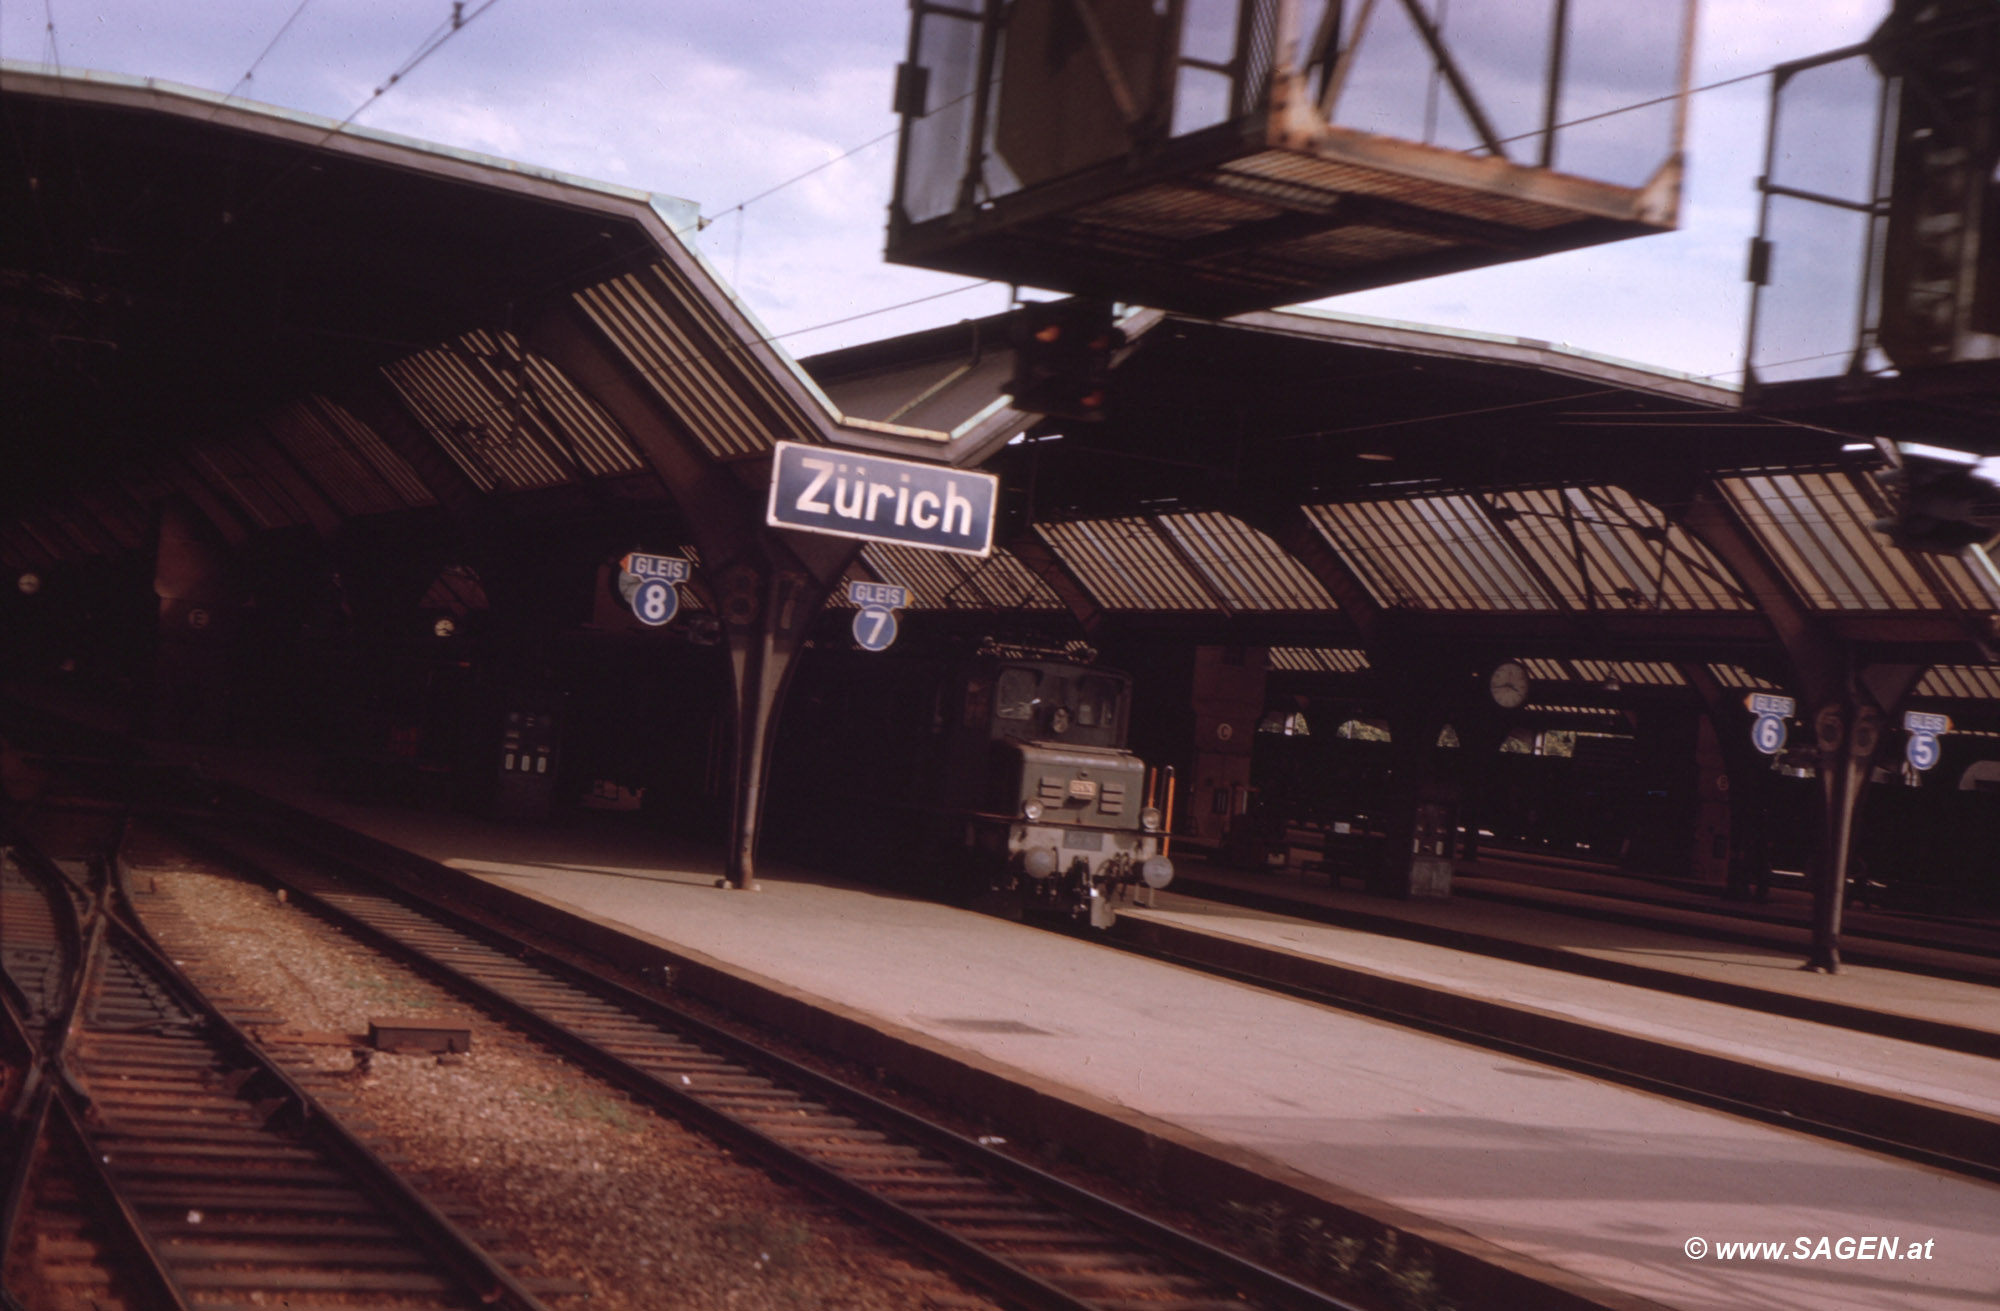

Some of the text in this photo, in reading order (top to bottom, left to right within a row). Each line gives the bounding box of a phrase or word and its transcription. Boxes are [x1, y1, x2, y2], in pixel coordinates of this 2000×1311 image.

[795, 457, 973, 537] Zürich
[635, 557, 683, 579] GLEIS
[644, 584, 667, 619] 8
[855, 584, 901, 605] GLEIS
[865, 611, 888, 645] 7
[1761, 718, 1779, 748] 6
[1915, 735, 1933, 764] 5
